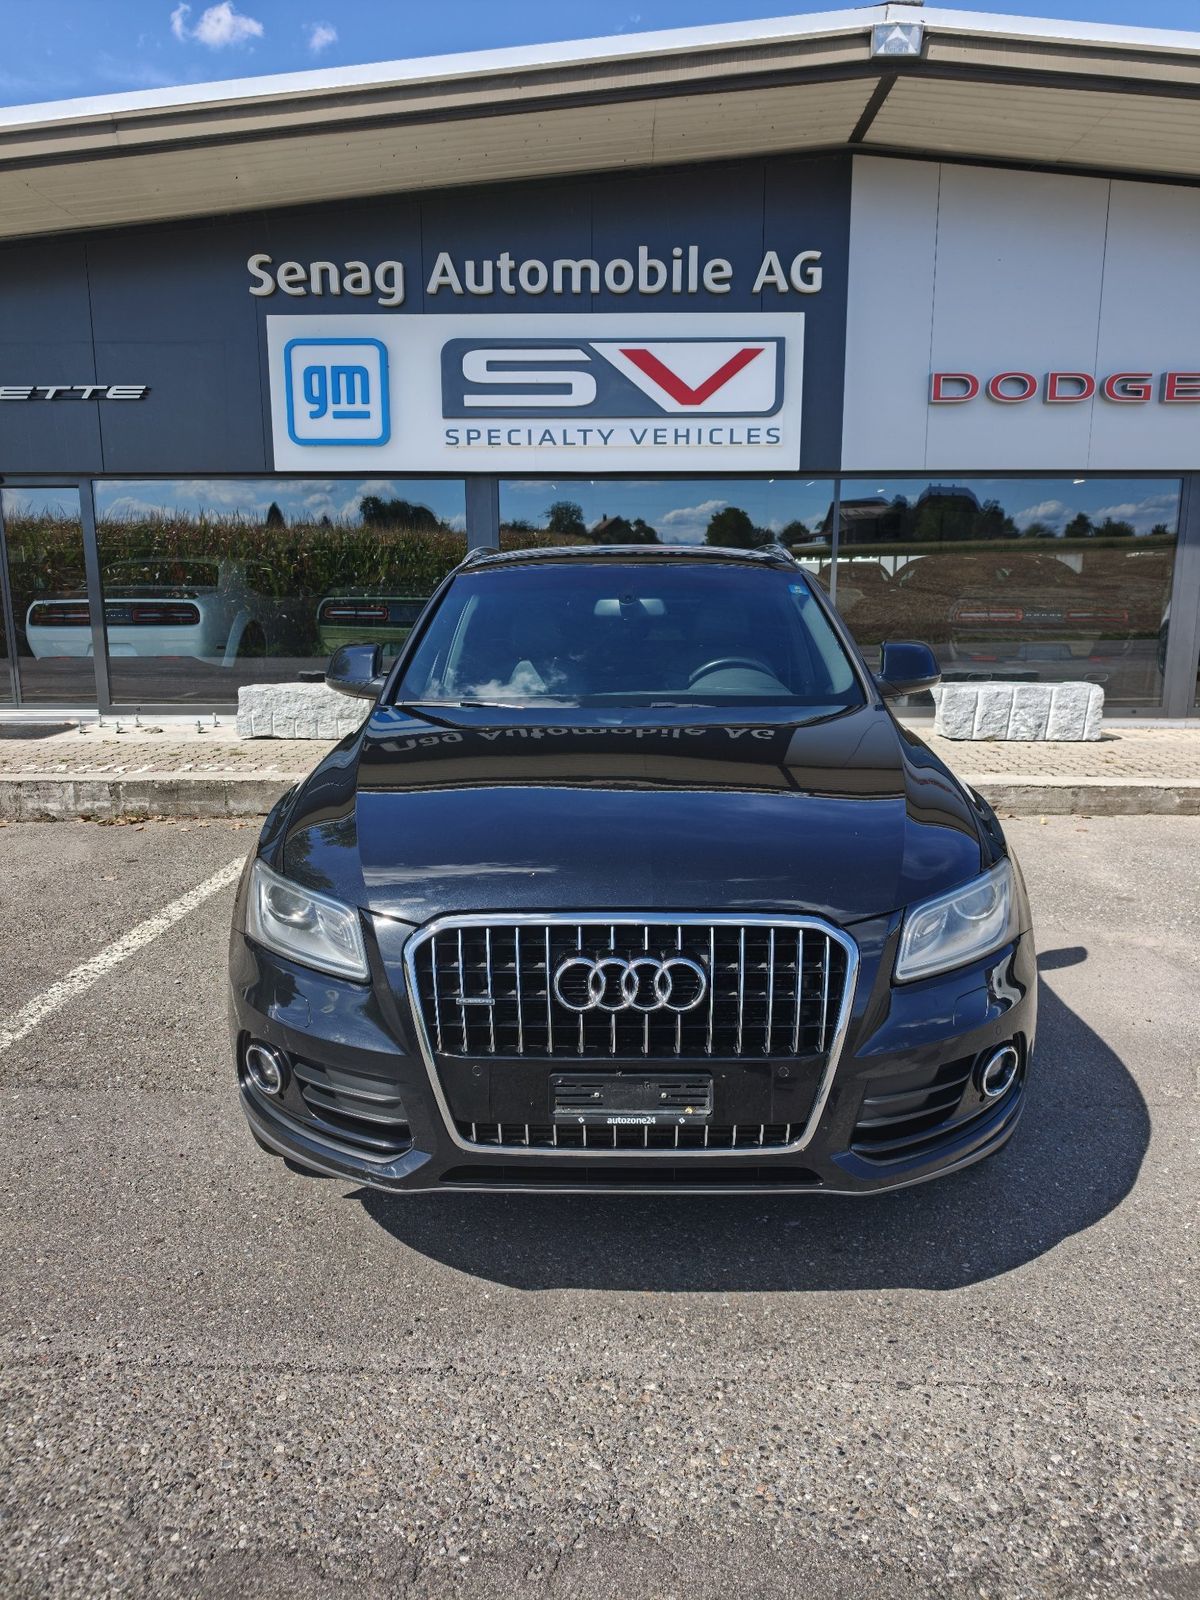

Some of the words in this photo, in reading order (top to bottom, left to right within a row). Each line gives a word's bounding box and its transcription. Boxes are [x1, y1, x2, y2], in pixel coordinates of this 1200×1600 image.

[247, 253, 406, 307] Senag
[426, 245, 733, 295] Automobile
[752, 250, 823, 294] AG
[0, 385, 146, 400] ETTE
[303, 365, 371, 419] gm
[461, 347, 766, 408] SV
[930, 372, 1200, 403] DODGE
[445, 428, 615, 446] SPECIALTY
[629, 427, 782, 445] VEHICLES
[607, 1116, 656, 1125] autozone24
